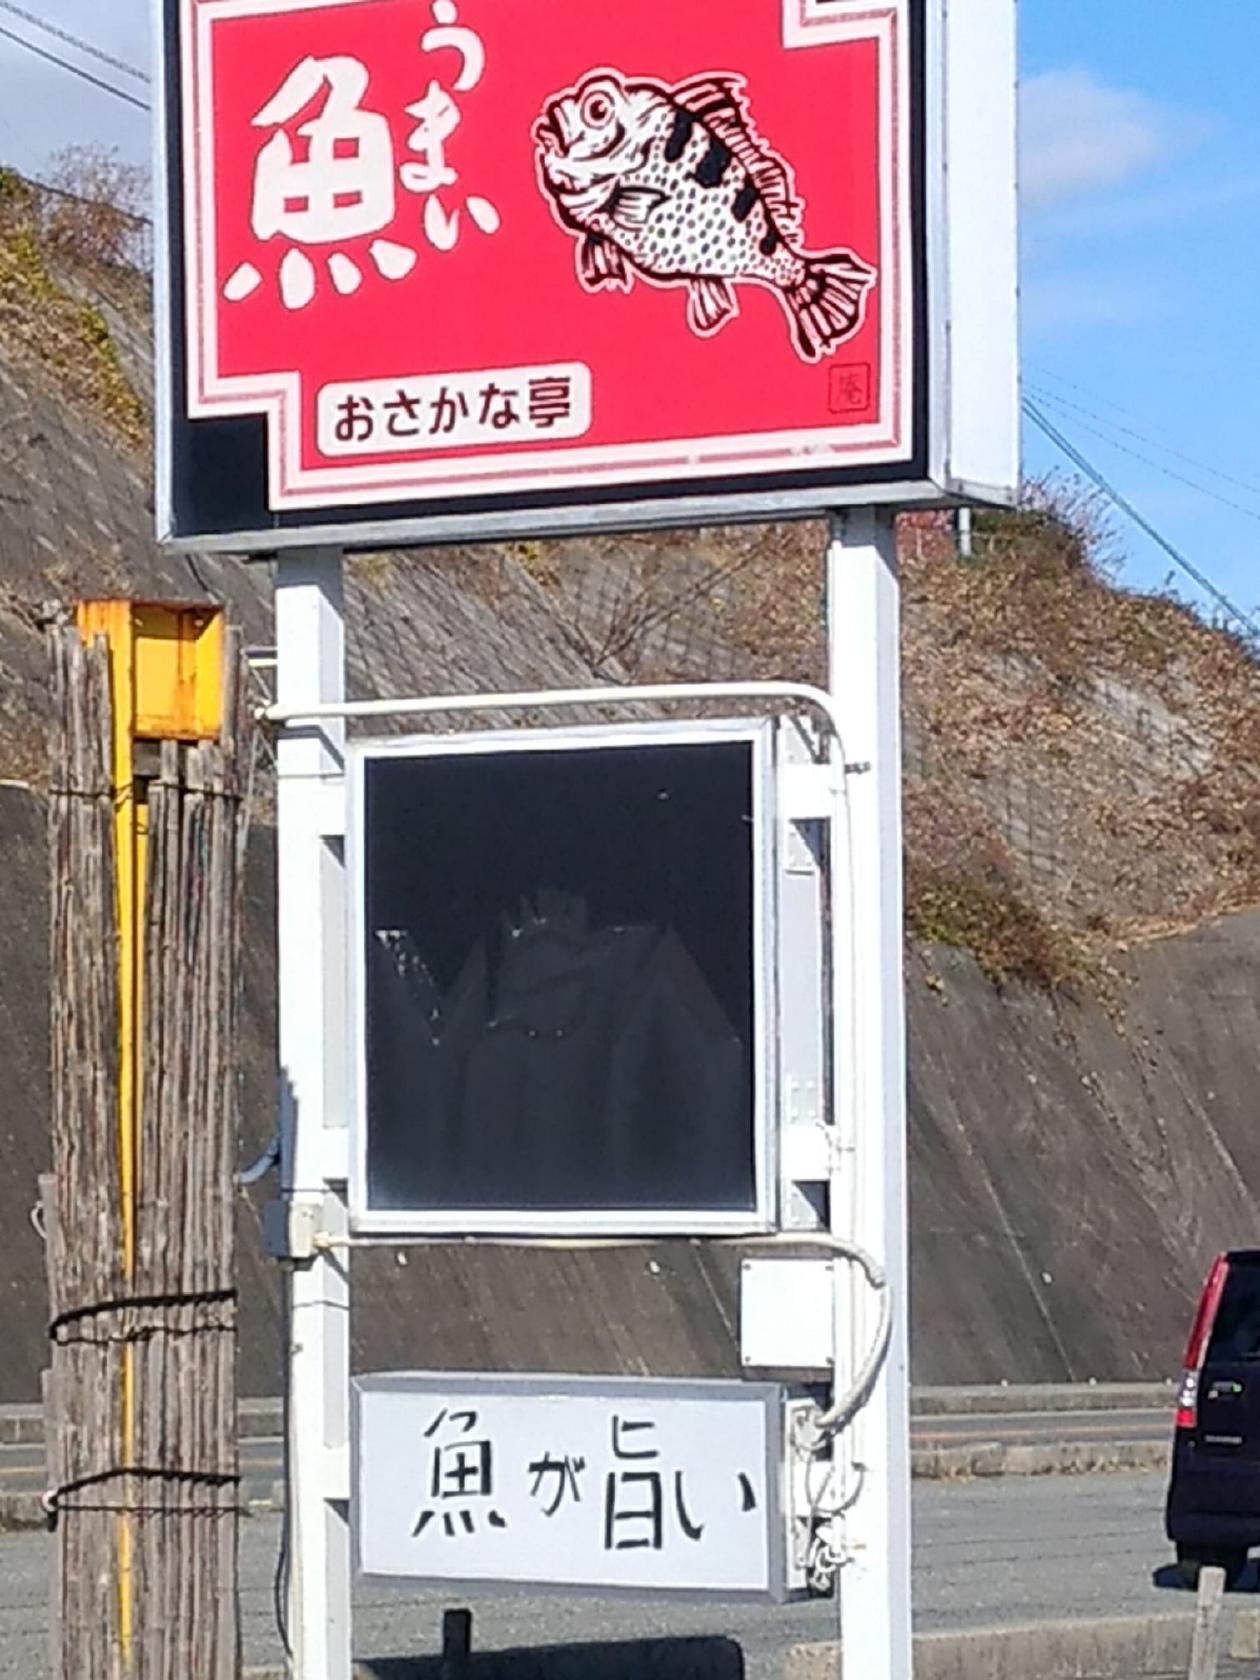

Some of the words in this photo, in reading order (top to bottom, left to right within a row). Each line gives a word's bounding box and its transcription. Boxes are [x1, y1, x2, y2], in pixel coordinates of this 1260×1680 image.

[223, 55, 417, 310] 魚
[400, 0, 500, 251] うまい
[335, 377, 571, 442] おさかな亭
[412, 1407, 757, 1550] 魚が旨い
